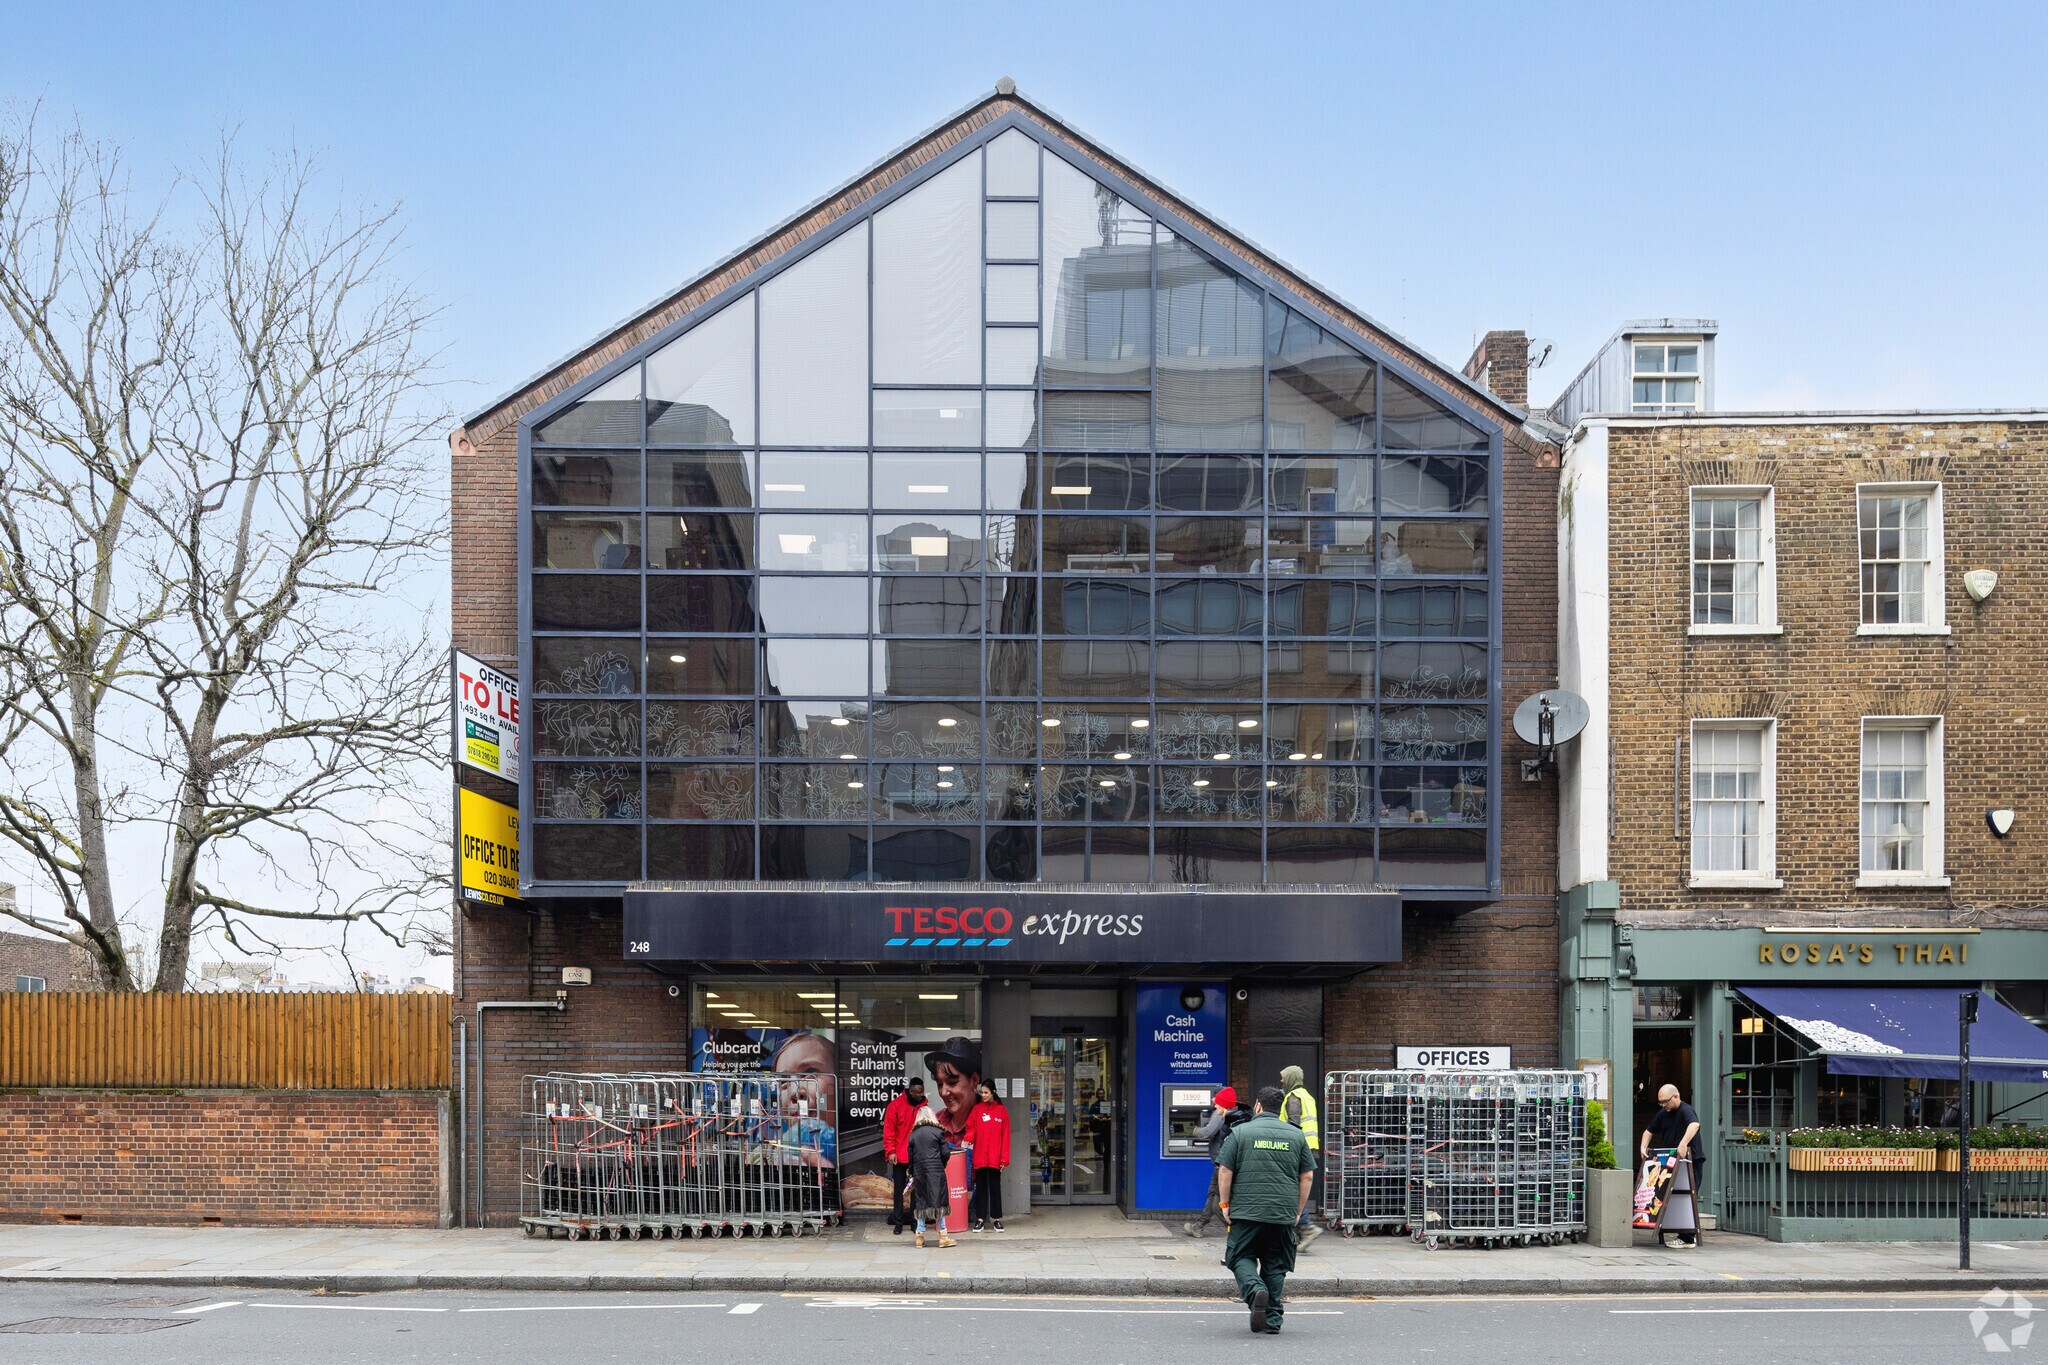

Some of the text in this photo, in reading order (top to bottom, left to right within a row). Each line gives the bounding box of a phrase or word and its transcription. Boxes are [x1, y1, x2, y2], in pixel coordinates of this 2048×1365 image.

[479, 668, 517, 697] OFFICE
[459, 672, 490, 708] TO
[460, 701, 478, 716] 1,493
[480, 712, 488, 723] sq
[490, 715, 496, 724] ft
[464, 834, 494, 865] OFFICE
[497, 844, 508, 869] TO
[484, 870, 497, 885] 020
[499, 874, 515, 890] 3940
[884, 907, 1144, 944] TESCO express
[630, 941, 650, 952] 248
[1759, 944, 1968, 964] ROSA'S THAI
[1166, 1014, 1196, 1026] Cash
[702, 1041, 760, 1054] Clubcard
[850, 1042, 897, 1058] Serving
[850, 1058, 904, 1070] Fulham's
[1417, 1051, 1490, 1066] OFFICES
[702, 1062, 726, 1070] Helping
[2042, 1070, 2048, 1078] R
[850, 1074, 909, 1088] shoppers
[850, 1092, 858, 1102] a
[860, 1090, 888, 1102] little
[850, 1107, 886, 1120] every
[1254, 1140, 1290, 1150] AMBULANCE
[1975, 1158, 2020, 1166] ROSA'S
